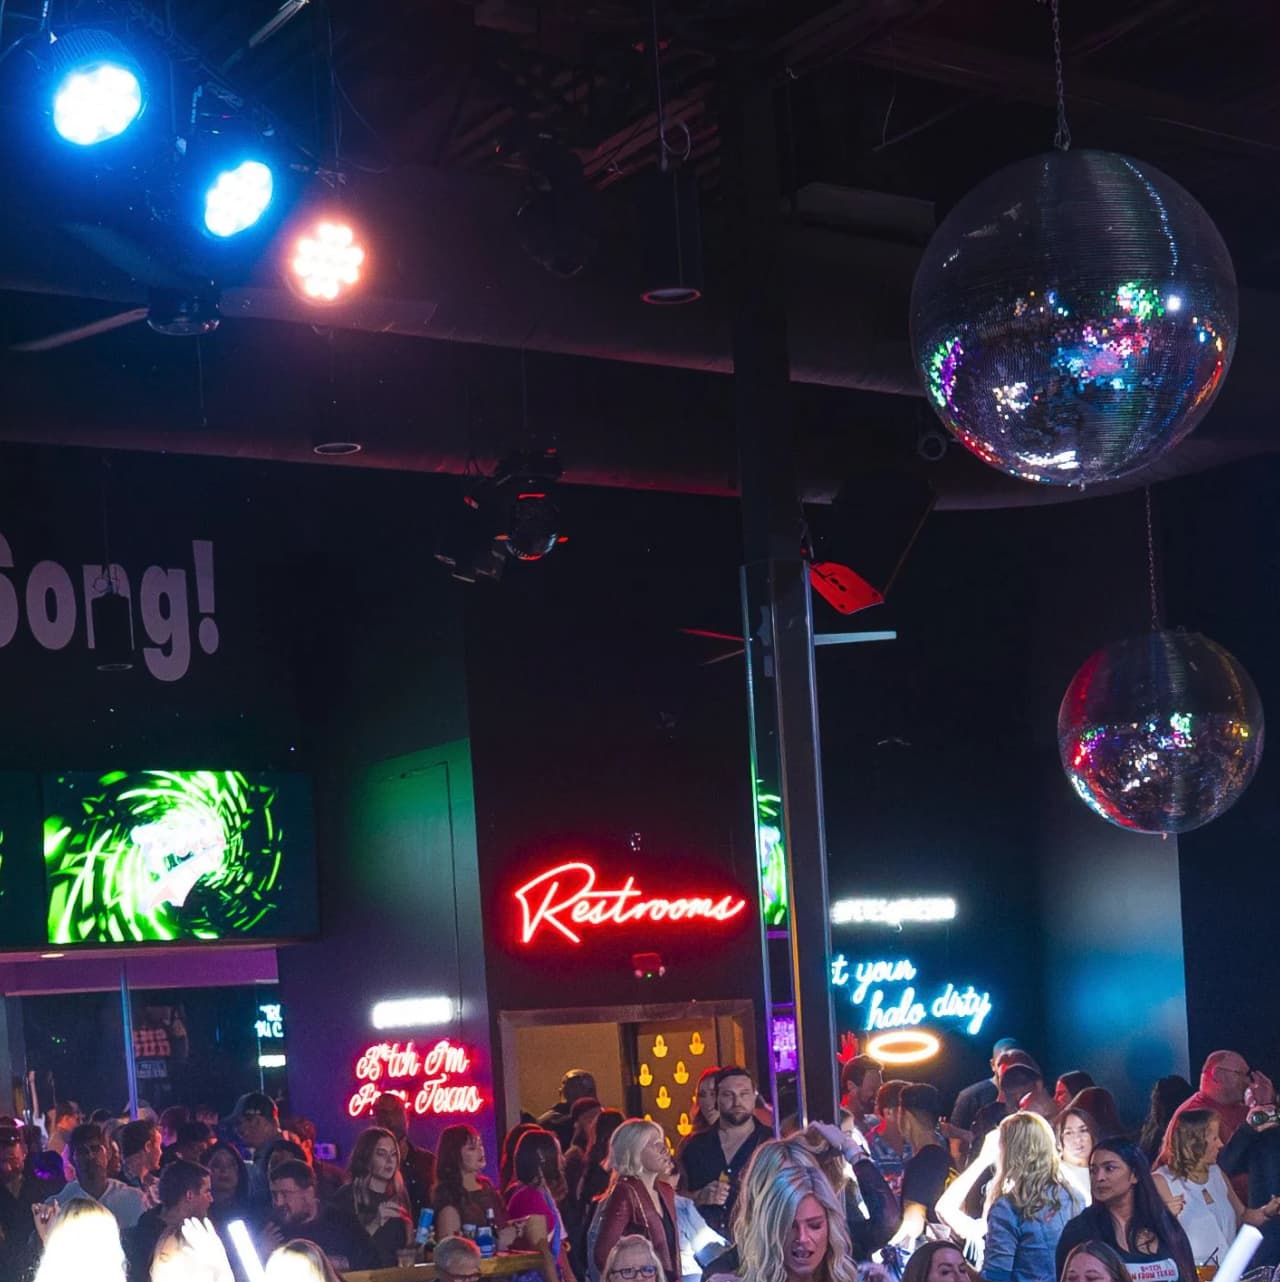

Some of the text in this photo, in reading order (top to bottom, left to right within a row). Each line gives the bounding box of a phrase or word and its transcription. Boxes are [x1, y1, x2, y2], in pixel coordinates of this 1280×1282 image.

[514, 861, 746, 944] Restrooms
[852, 959, 917, 1004] your
[865, 983, 992, 1035] halo dirty
[415, 1074, 484, 1114] Texas
